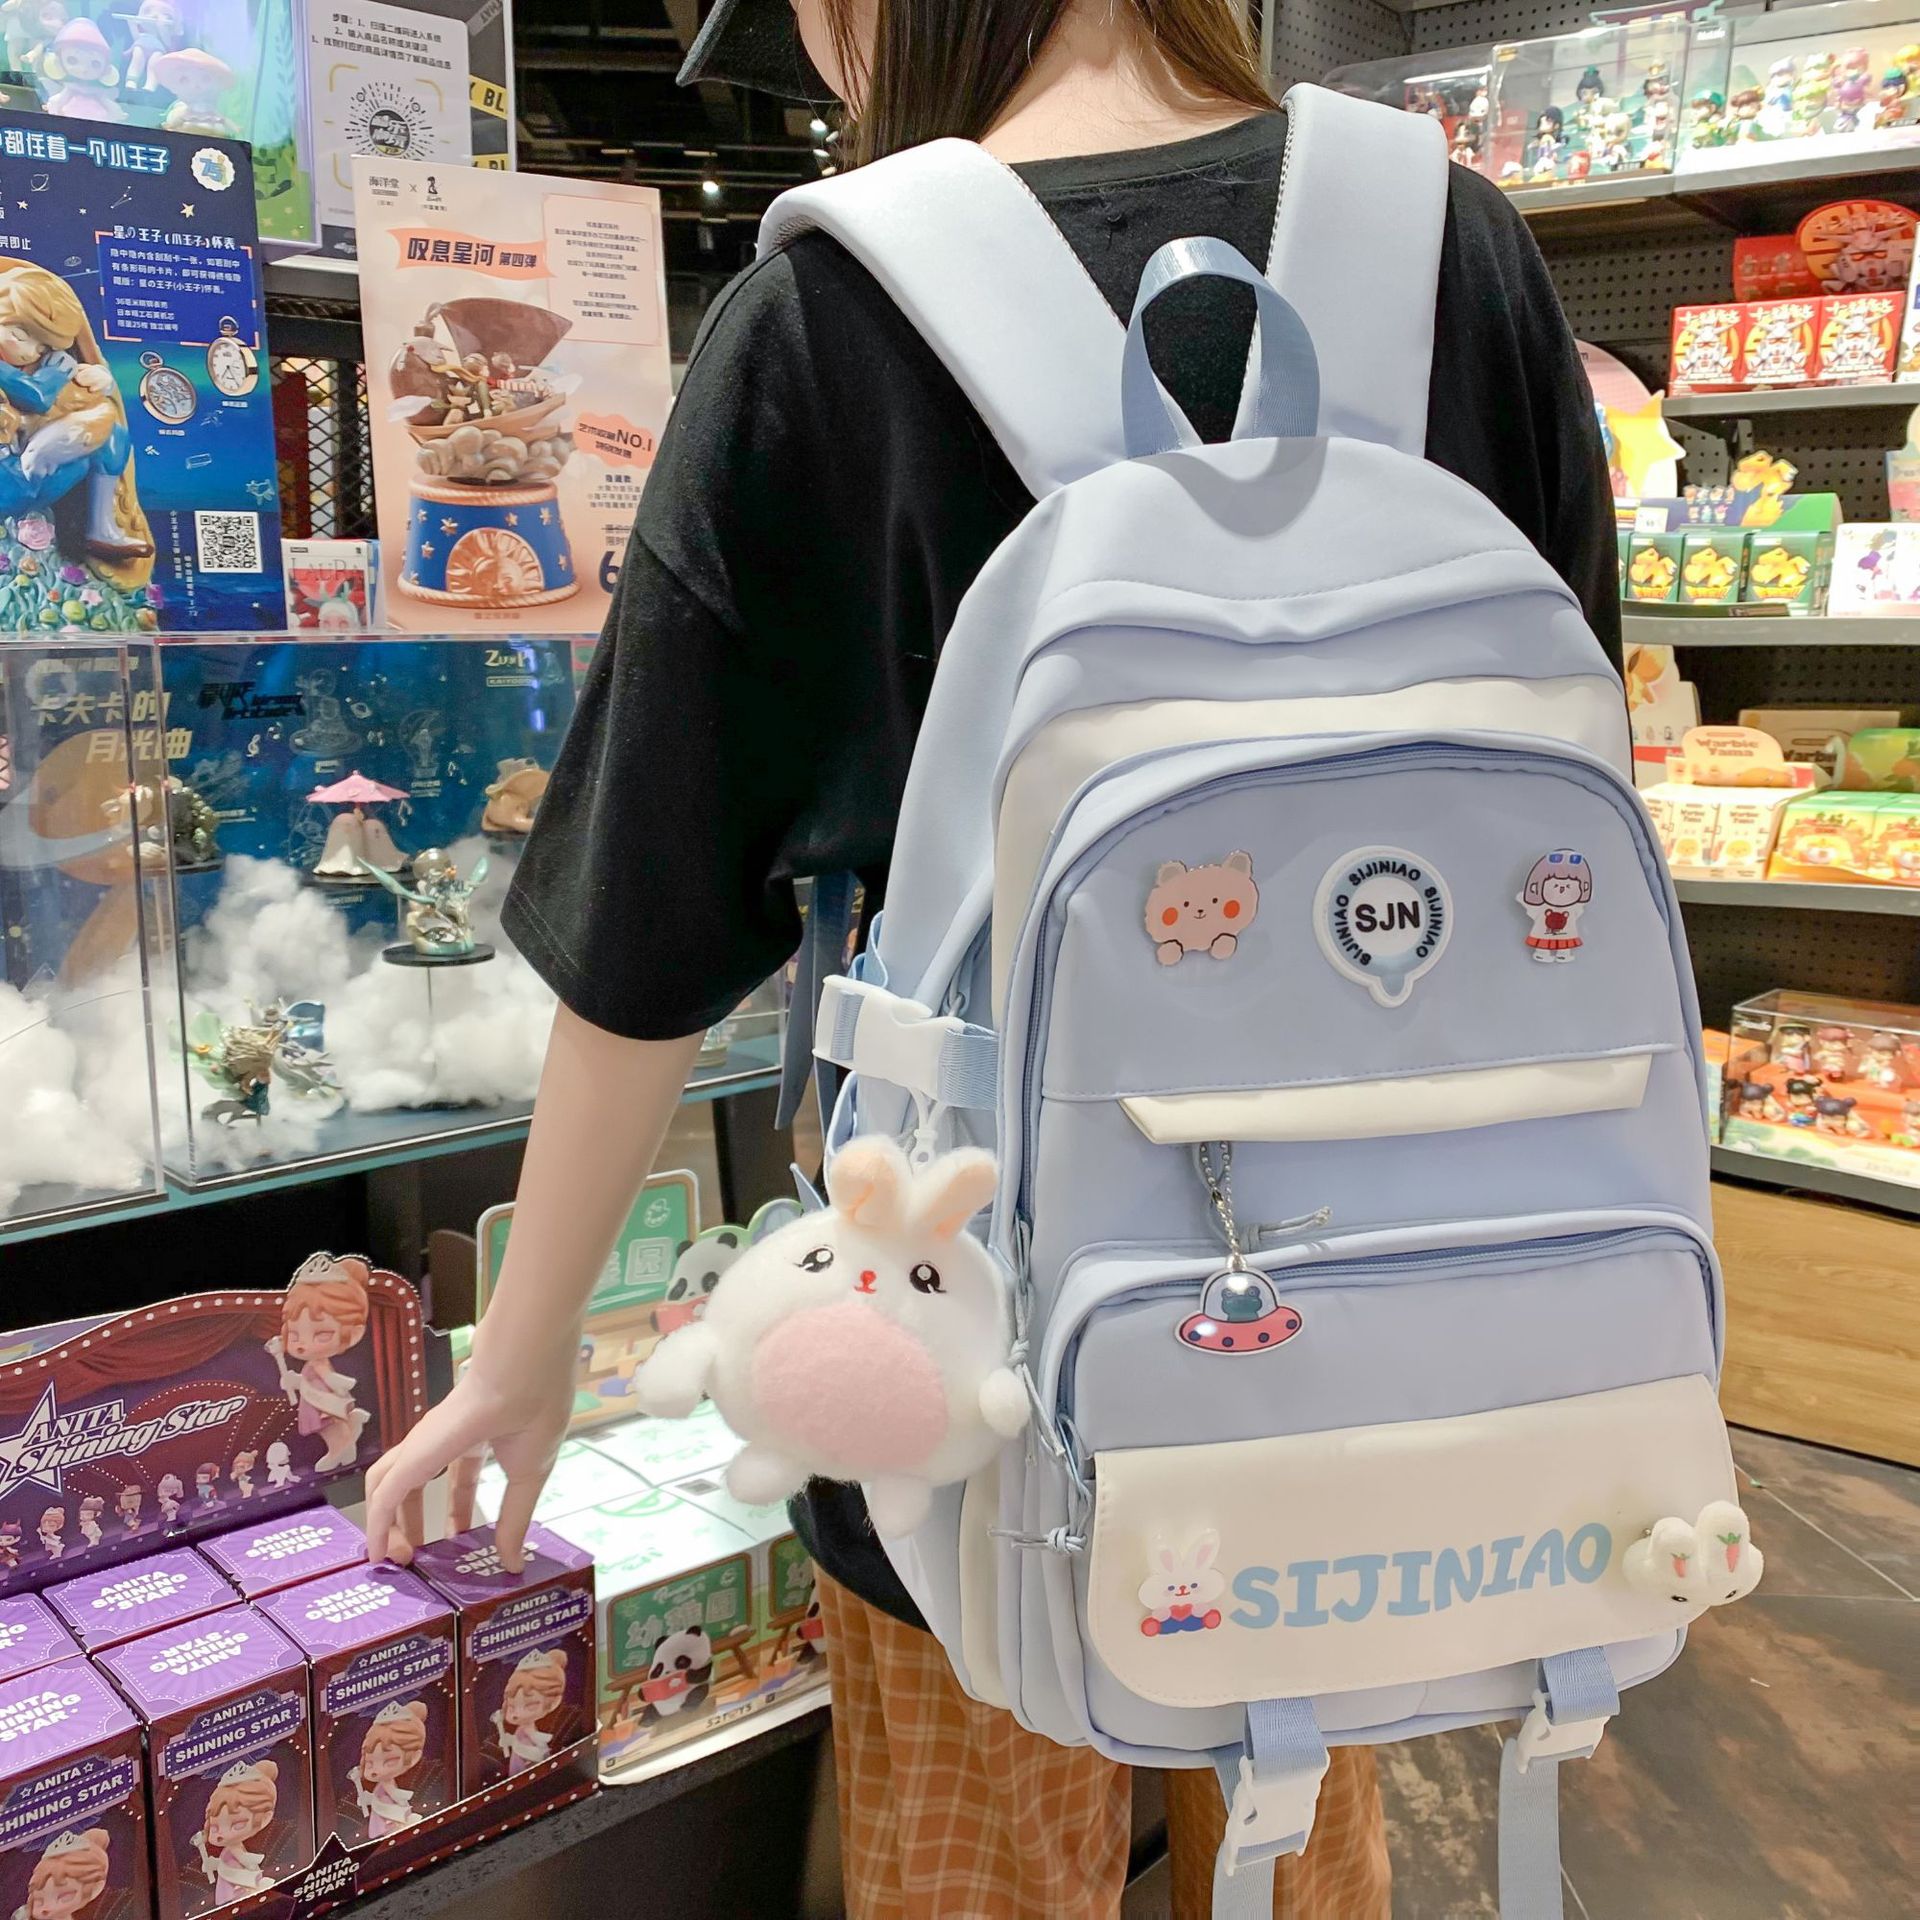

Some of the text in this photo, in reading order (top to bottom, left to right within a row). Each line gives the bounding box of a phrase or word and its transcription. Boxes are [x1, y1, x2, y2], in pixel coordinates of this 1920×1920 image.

[0, 130, 168, 172] 都住着一个小王子
[407, 237, 537, 269] 叹息星河 第四弹
[1348, 860, 1421, 887] SIJINIAO
[1333, 894, 1372, 966] SIJINIAO
[1354, 900, 1421, 933] SJN
[1415, 886, 1444, 959] SIJINIAO
[7, 1396, 248, 1482] Shining Star
[21, 1401, 123, 1448] ANITA
[245, 1526, 334, 1558] SHINING
[252, 1525, 316, 1548] ANITA
[269, 1538, 326, 1560] STAR
[91, 1573, 189, 1609] SHINING
[101, 1570, 170, 1597] ANITA
[1229, 1521, 1615, 1630] SIJINIAO
[117, 1586, 178, 1610] STAR
[305, 1584, 397, 1621] SHINING
[313, 1583, 371, 1607] STAR
[325, 1596, 391, 1624] ANITA
[511, 1593, 549, 1615] ANITA
[480, 1603, 581, 1648] SHINING STAR
[149, 1632, 250, 1673] SHINING
[159, 1631, 223, 1658] STAR
[170, 1644, 242, 1676] ANITA
[369, 1643, 408, 1665] ANITA
[335, 1653, 441, 1700] SHINING STAR
[0, 1710, 70, 1742] STAR
[212, 1700, 255, 1724] ANITA
[175, 1708, 292, 1763] SHINING STAR
[33, 1766, 82, 1794] ANITA
[77, 1774, 124, 1802] STAR
[293, 1862, 360, 1897] SHINING
[303, 1856, 352, 1884] ANITA
[304, 1877, 346, 1902] STAR
